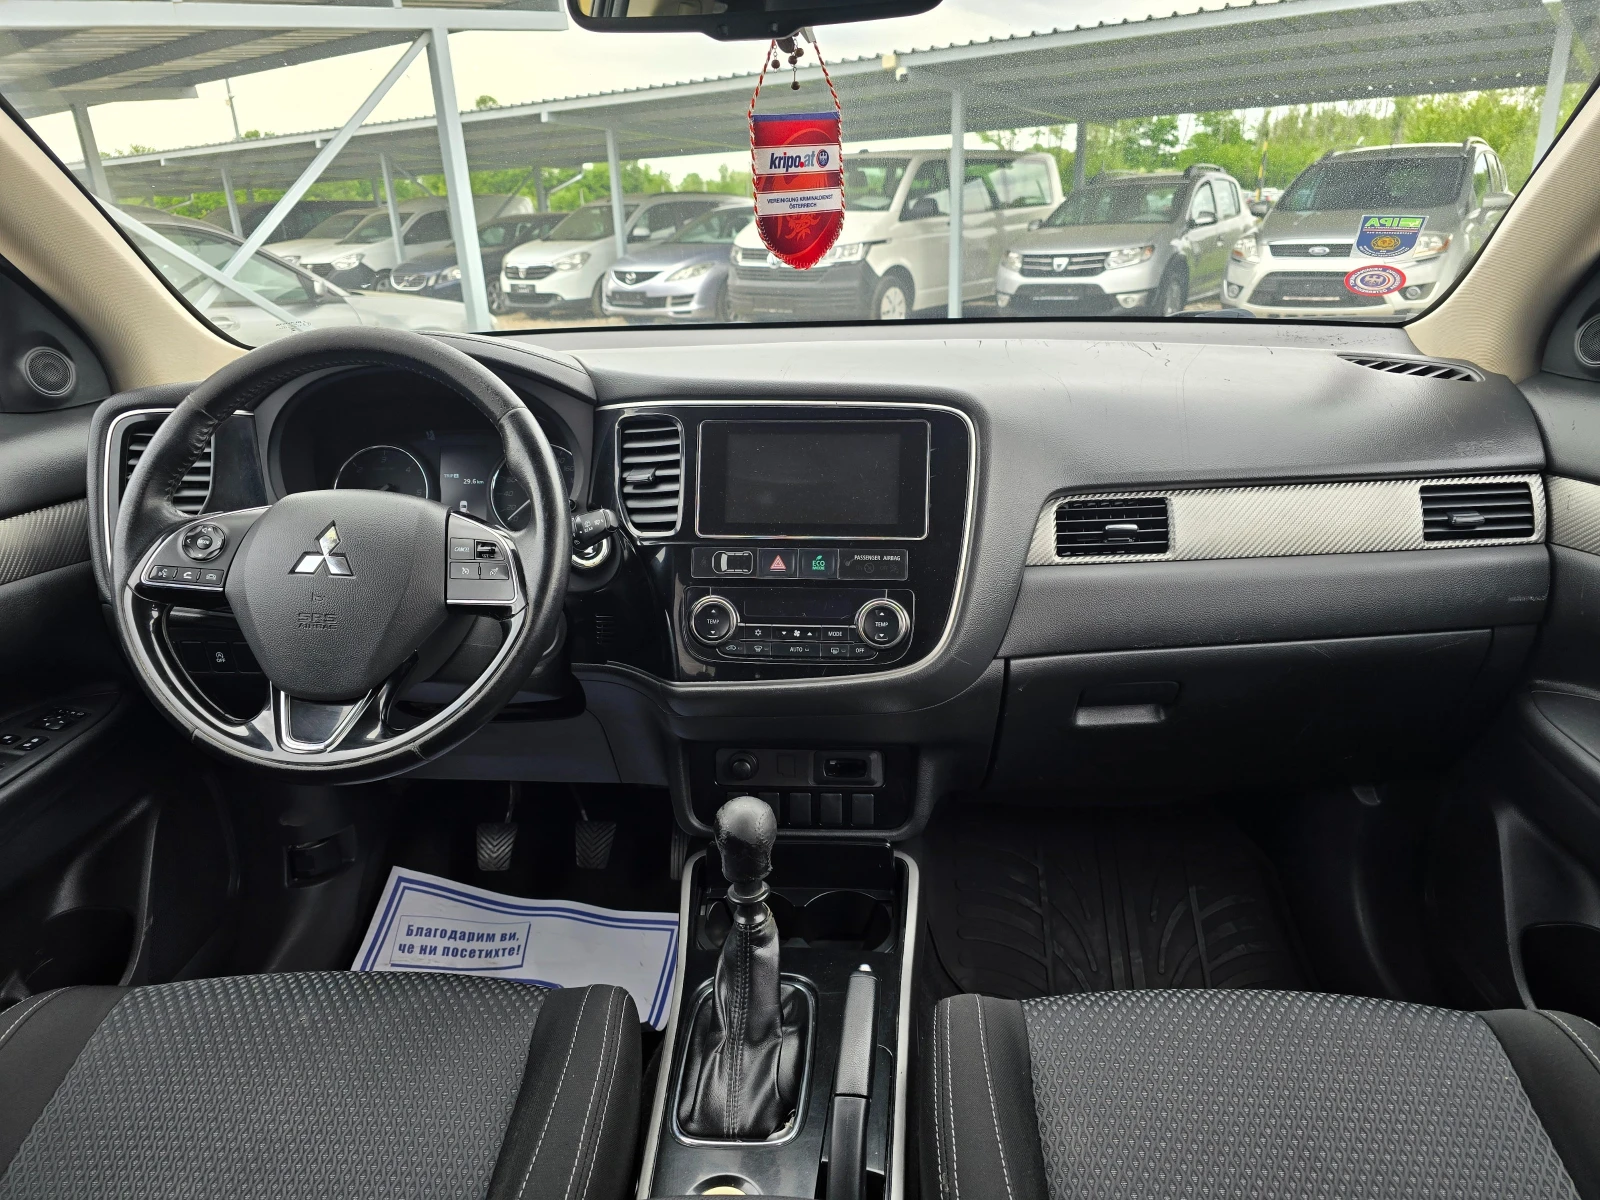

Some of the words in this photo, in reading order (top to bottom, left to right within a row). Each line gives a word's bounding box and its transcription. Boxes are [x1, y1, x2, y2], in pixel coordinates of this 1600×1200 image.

[769, 150, 816, 172] kripo.at
[767, 196, 799, 204] VEREINIGUNG
[800, 193, 833, 202] KRIMINALDIENST
[405, 924, 496, 943] Благодарим
[499, 932, 520, 942] ви,
[398, 943, 415, 954] че
[418, 944, 438, 956] ни
[441, 944, 521, 959] посетихте!
